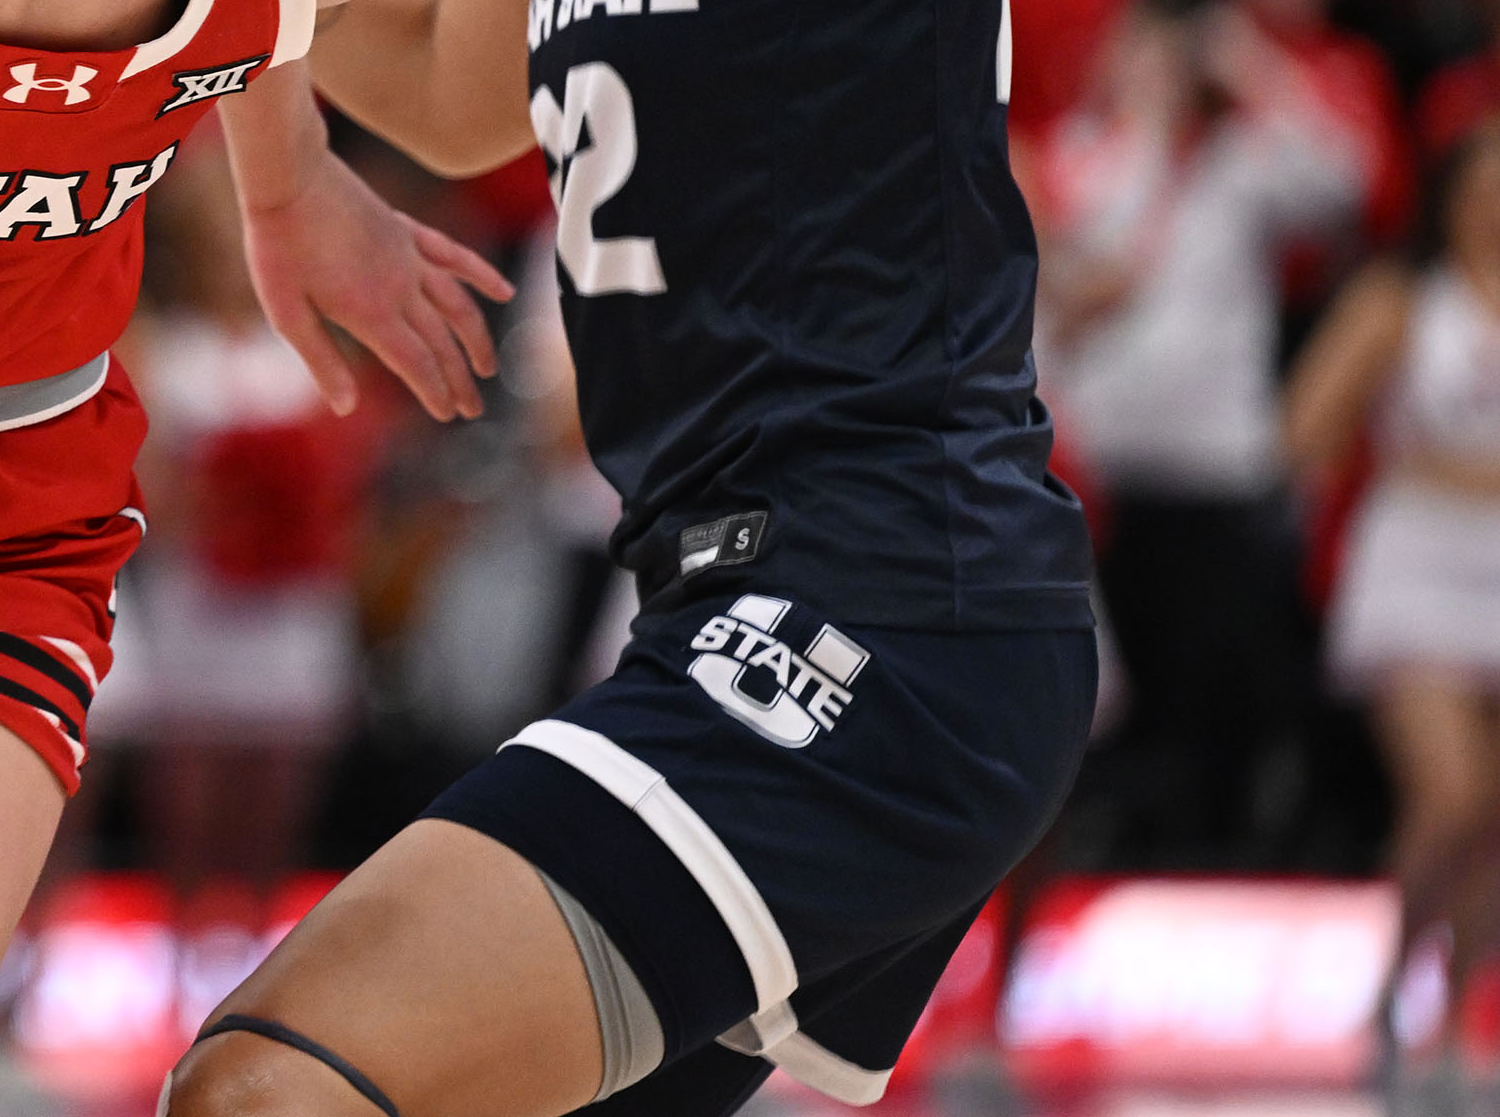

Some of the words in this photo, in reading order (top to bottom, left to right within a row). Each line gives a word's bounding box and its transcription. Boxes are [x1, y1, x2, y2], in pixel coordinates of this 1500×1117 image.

[160, 56, 268, 117] XII
[734, 527, 750, 550] S
[690, 615, 854, 732] STATE
